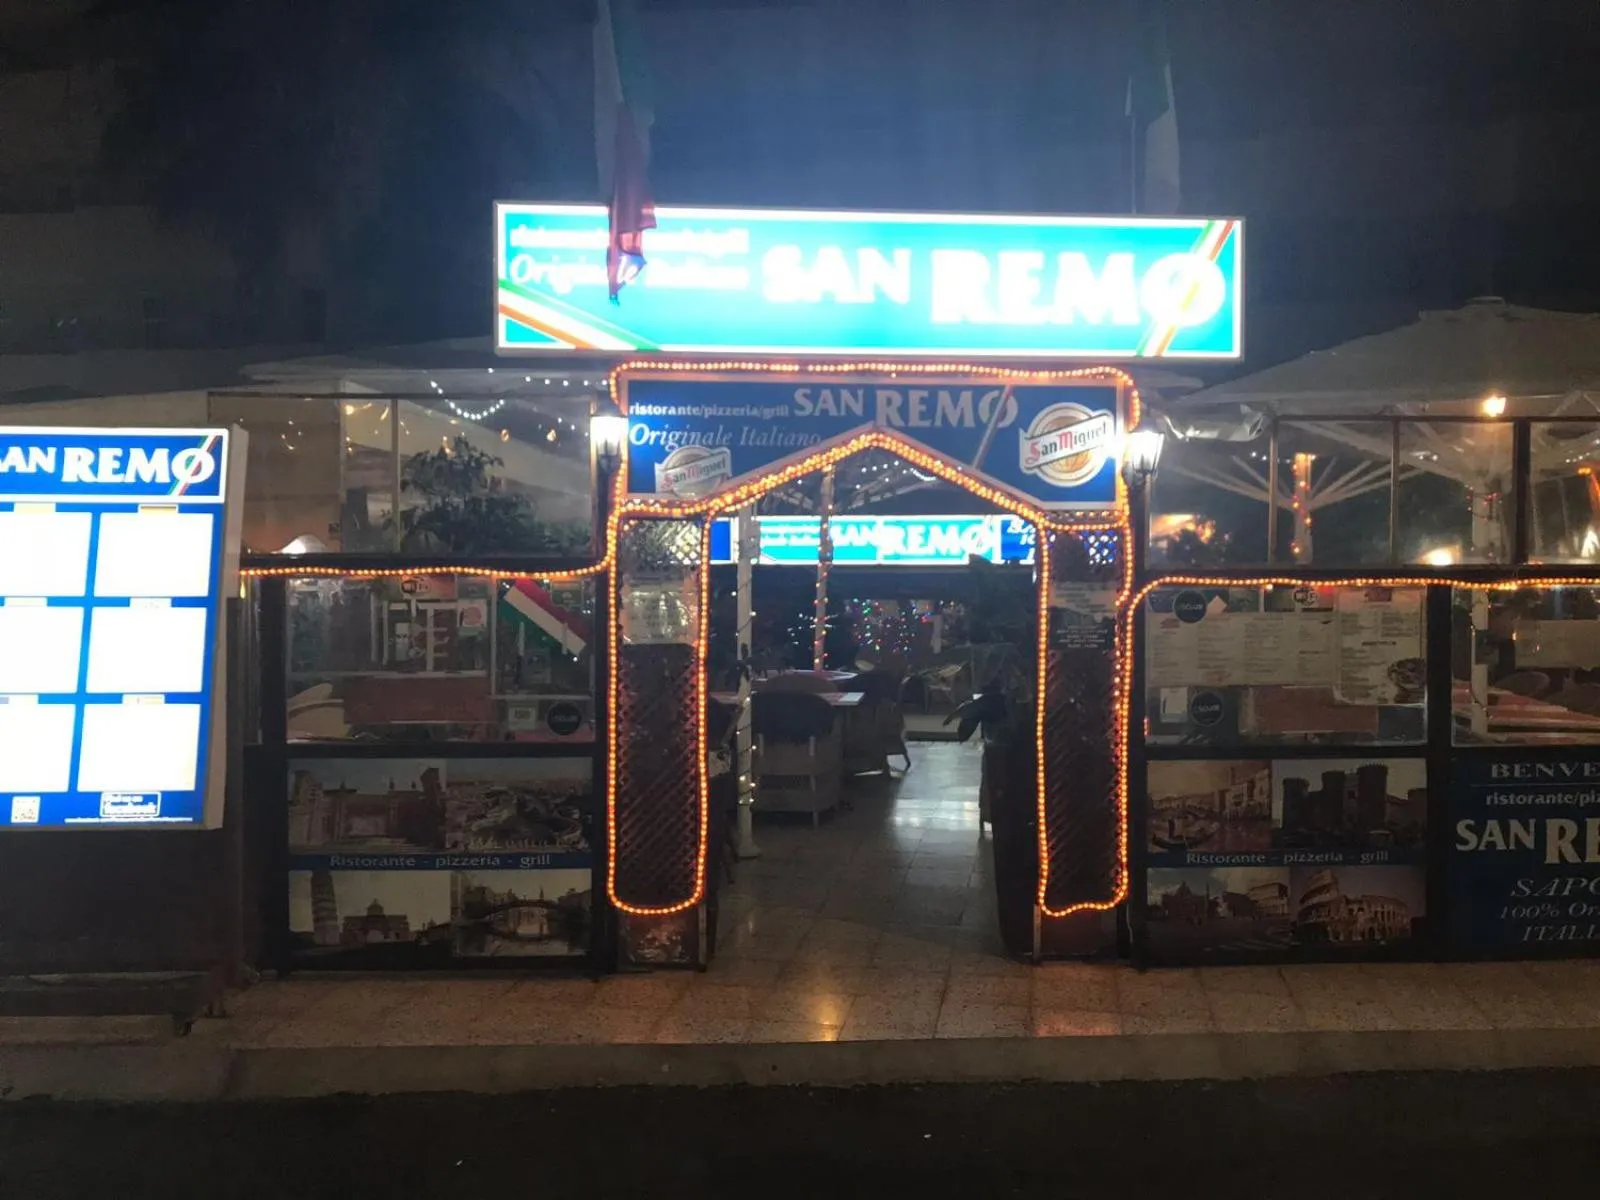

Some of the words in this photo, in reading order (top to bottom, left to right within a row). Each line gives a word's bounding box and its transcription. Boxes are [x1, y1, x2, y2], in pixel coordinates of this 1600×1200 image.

[762, 243, 912, 304] SAN
[629, 402, 790, 420] ristorante/pizzeria/grill
[793, 388, 864, 417] SAN
[875, 389, 1019, 428] REMO
[629, 423, 732, 451] Originale
[738, 425, 823, 447] Italiano
[0, 445, 57, 474] AN
[61, 447, 215, 485] REMO
[1455, 818, 1536, 852] SAN
[329, 854, 416, 867] Ristorante
[435, 854, 501, 868] pizzeria
[520, 853, 551, 868] grill
[1186, 852, 1266, 864] Ristorante
[1283, 852, 1343, 864] pizzeria
[1360, 851, 1389, 864] grill
[1500, 902, 1560, 920] 100%
[1568, 901, 1600, 917] Or
[1522, 924, 1600, 941] ITALI
